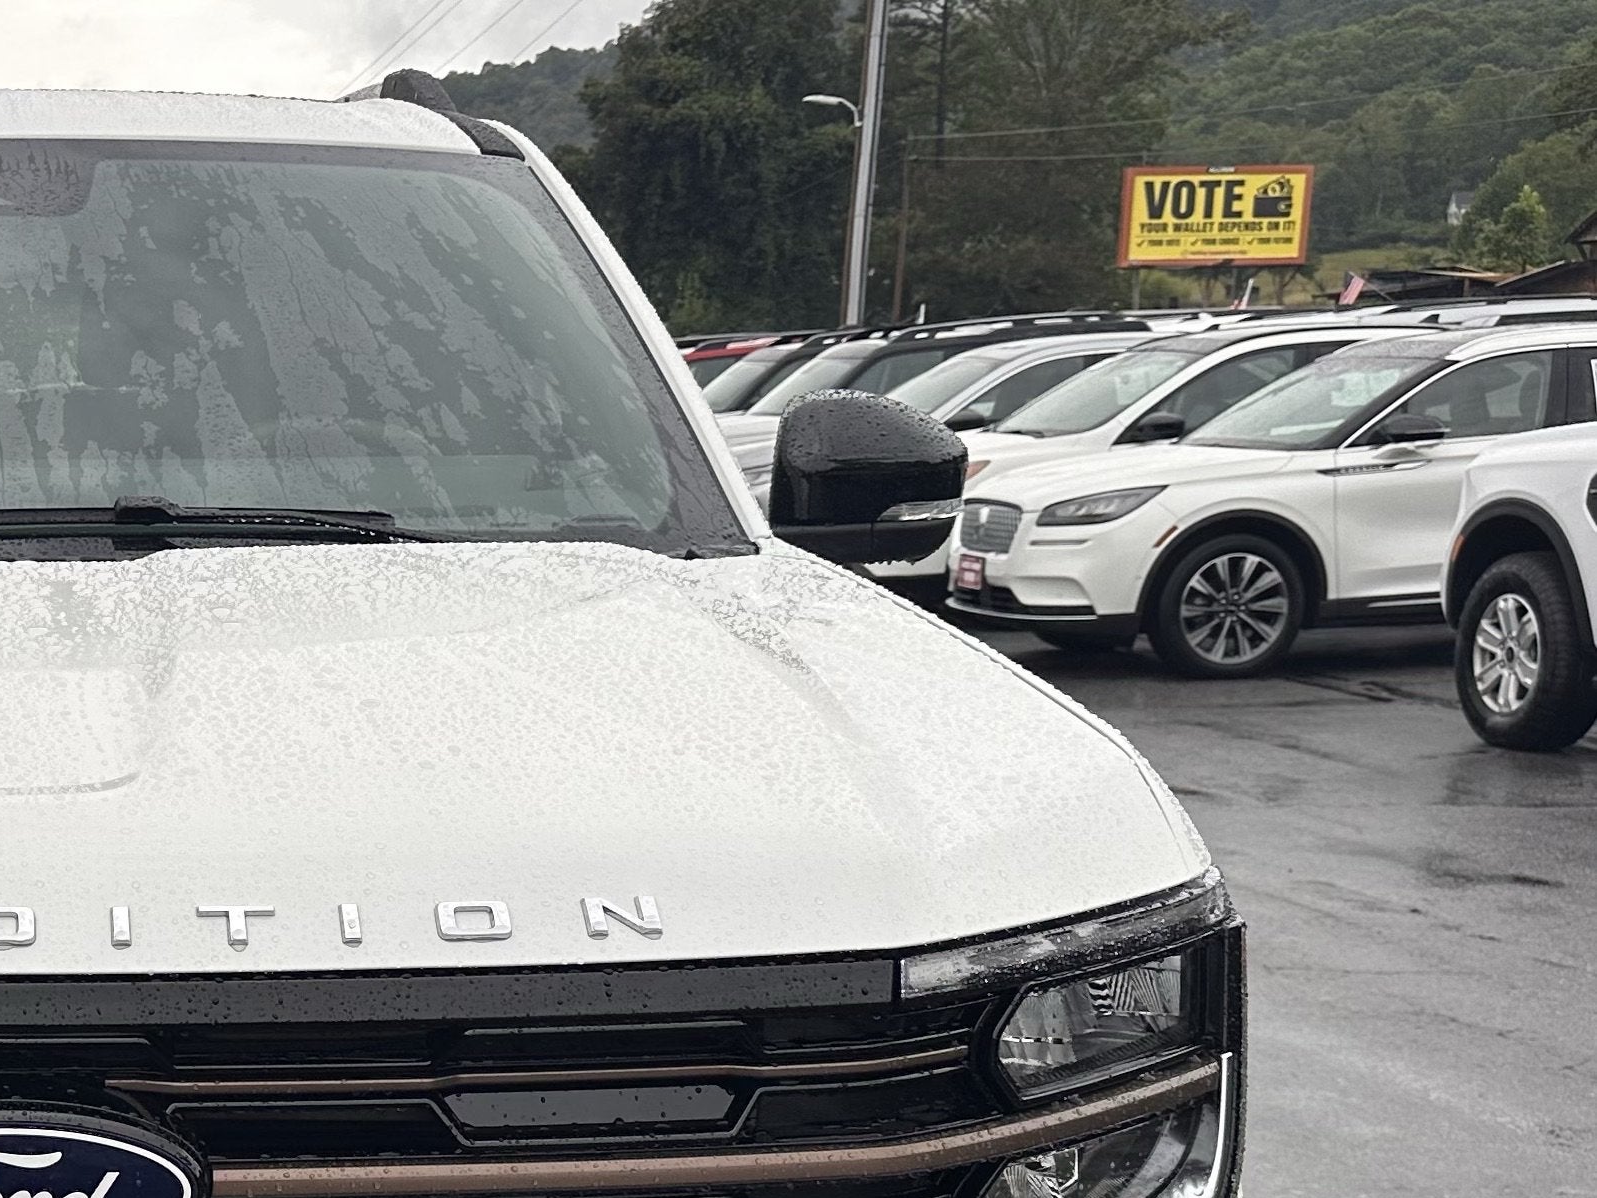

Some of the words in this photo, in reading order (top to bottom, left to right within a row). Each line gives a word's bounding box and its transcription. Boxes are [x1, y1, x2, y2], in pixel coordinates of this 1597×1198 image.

[1144, 180, 1245, 219] VOTE
[1139, 222, 1168, 233] YOUR
[1173, 222, 1215, 233] WALLET
[1218, 221, 1263, 232] DEPENDS
[1266, 221, 1280, 231] ON
[1283, 220, 1296, 231] IT!
